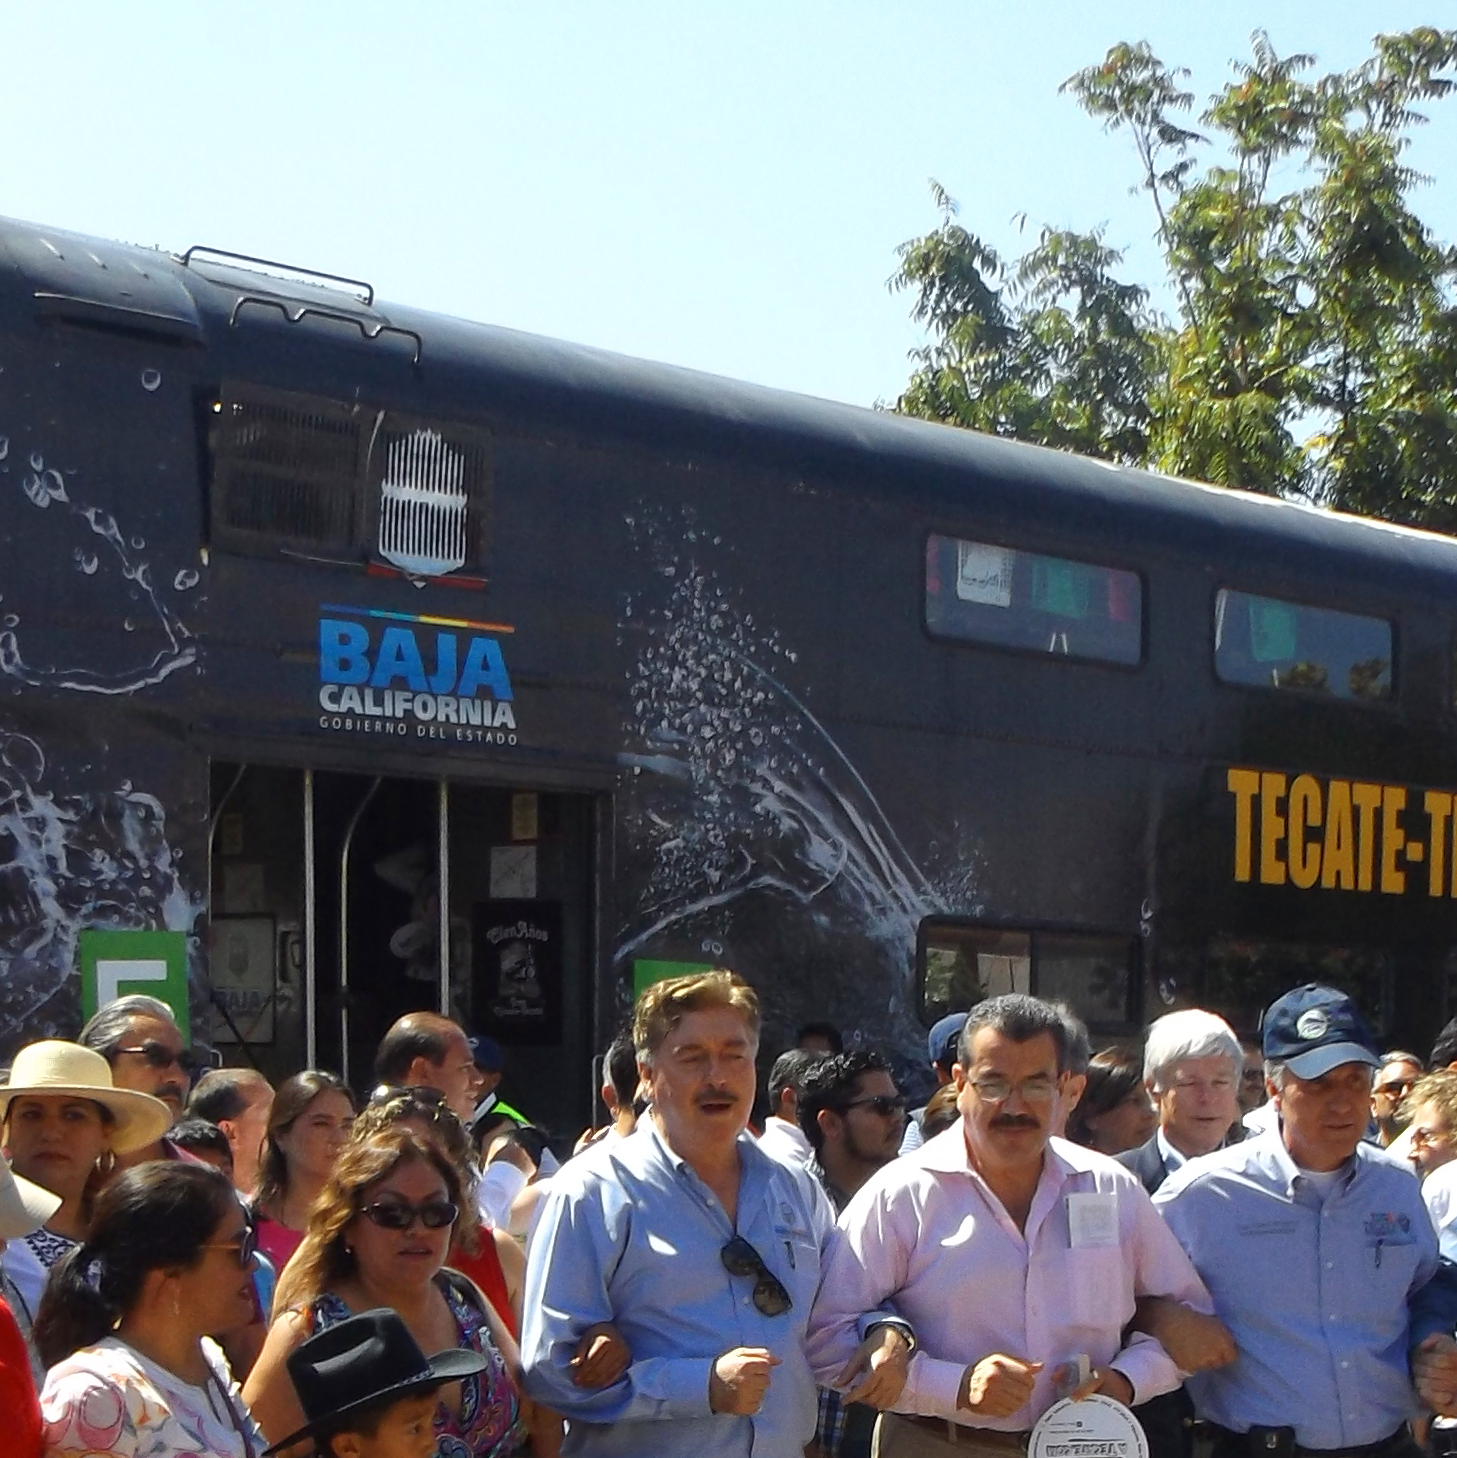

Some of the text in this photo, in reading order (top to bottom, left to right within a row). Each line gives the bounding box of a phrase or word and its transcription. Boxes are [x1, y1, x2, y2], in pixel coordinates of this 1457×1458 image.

[319, 618, 514, 700] BAJA
[318, 684, 517, 729] CALIFORNIA
[319, 715, 518, 747] GOBIERNO DEL ESTADO
